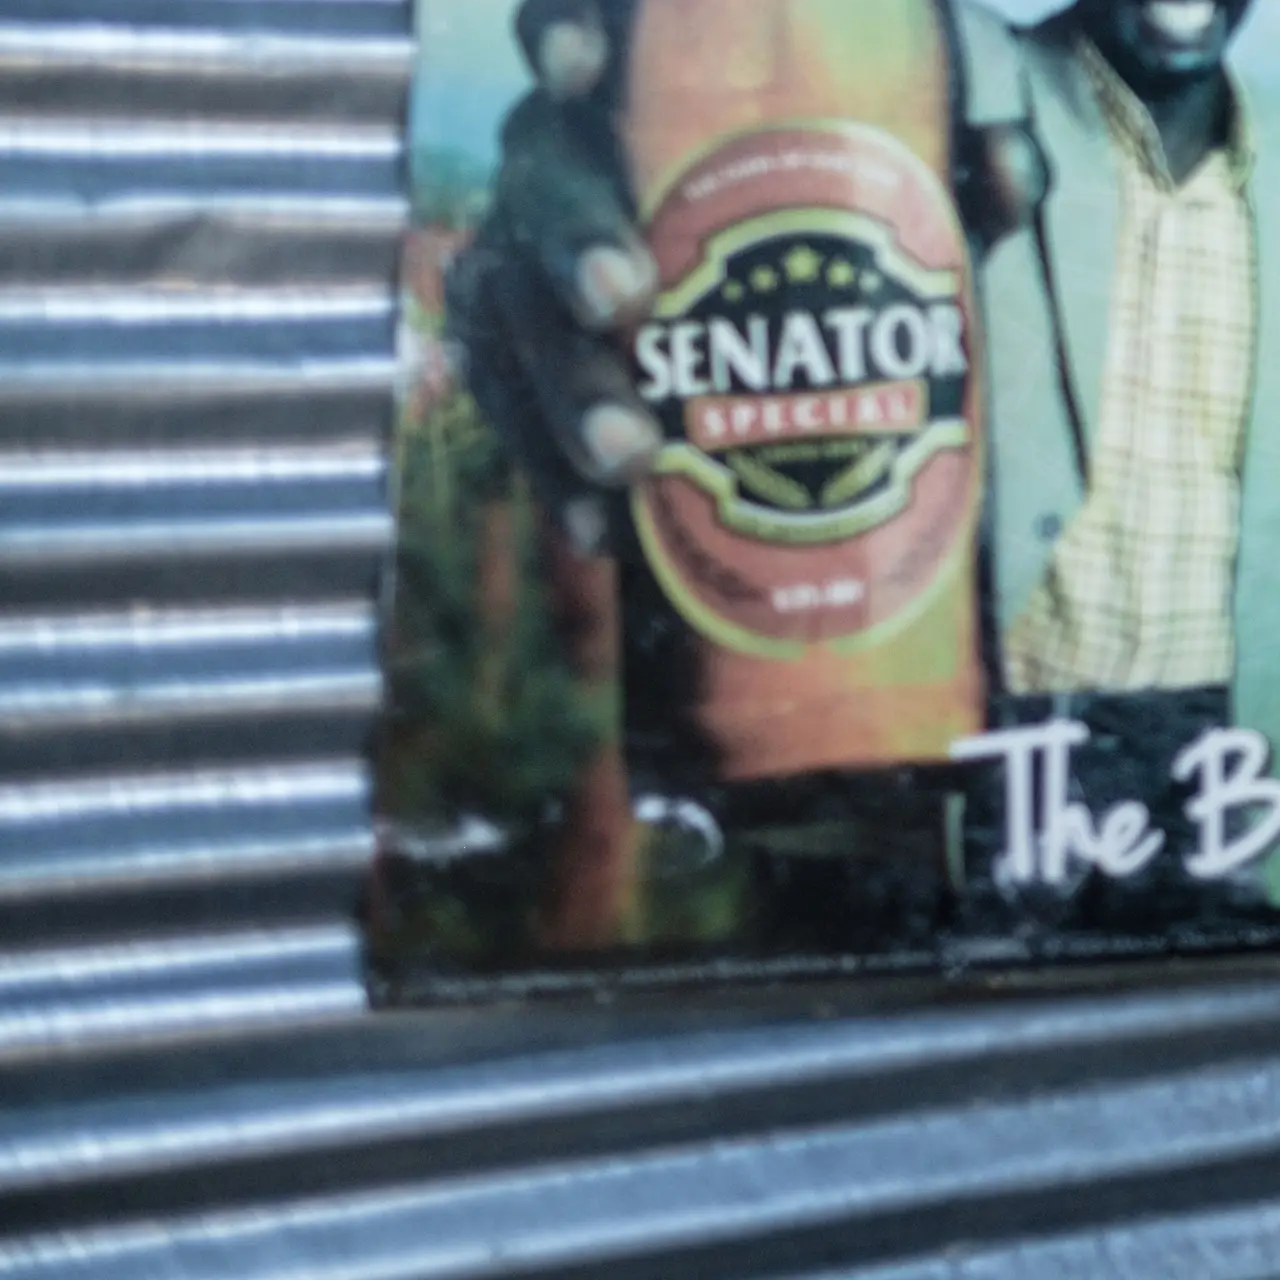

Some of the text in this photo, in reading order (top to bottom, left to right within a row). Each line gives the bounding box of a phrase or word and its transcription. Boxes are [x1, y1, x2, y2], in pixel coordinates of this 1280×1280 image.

[634, 303, 967, 400] SENATOR
[702, 384, 918, 440] SPECIAL
[949, 718, 1164, 883] The
